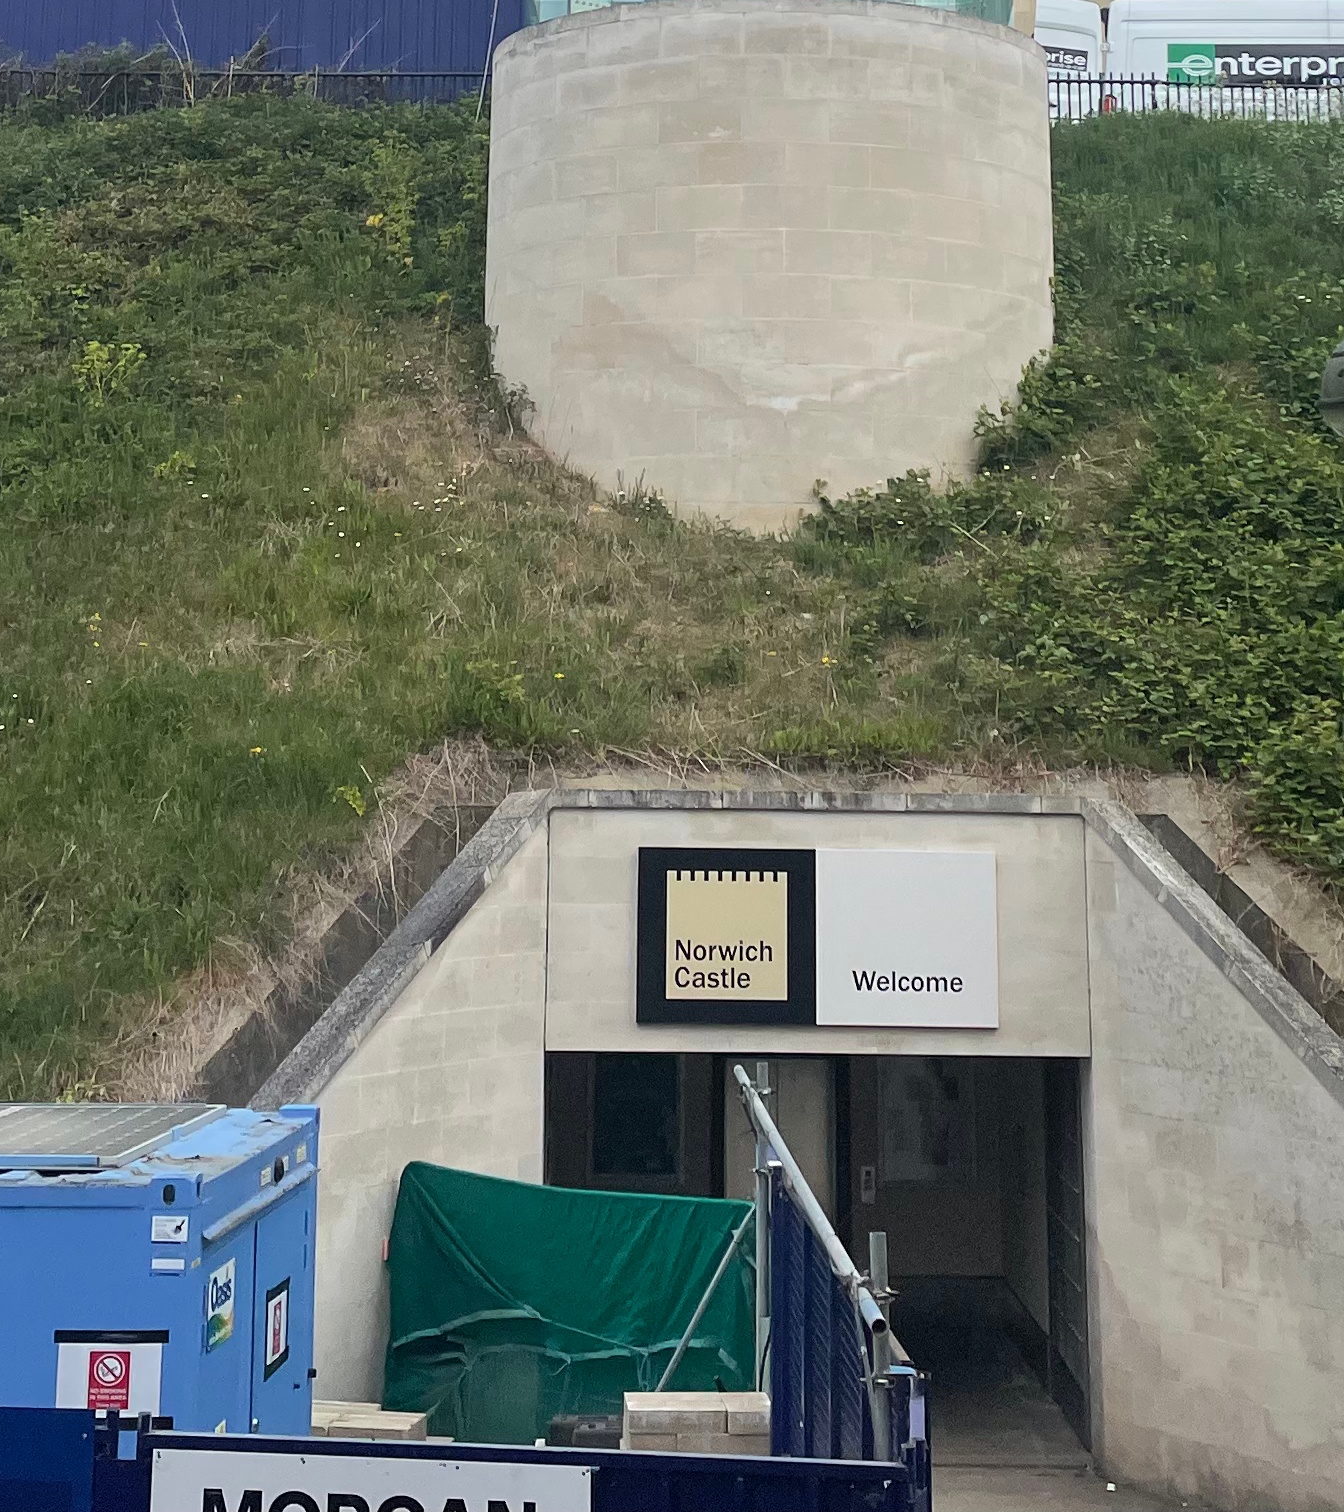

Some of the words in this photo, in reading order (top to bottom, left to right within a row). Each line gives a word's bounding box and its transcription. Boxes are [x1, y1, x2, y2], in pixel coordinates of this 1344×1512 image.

[675, 939, 773, 962] Norwich
[674, 966, 751, 989] Castle
[851, 970, 963, 993] Welcome
